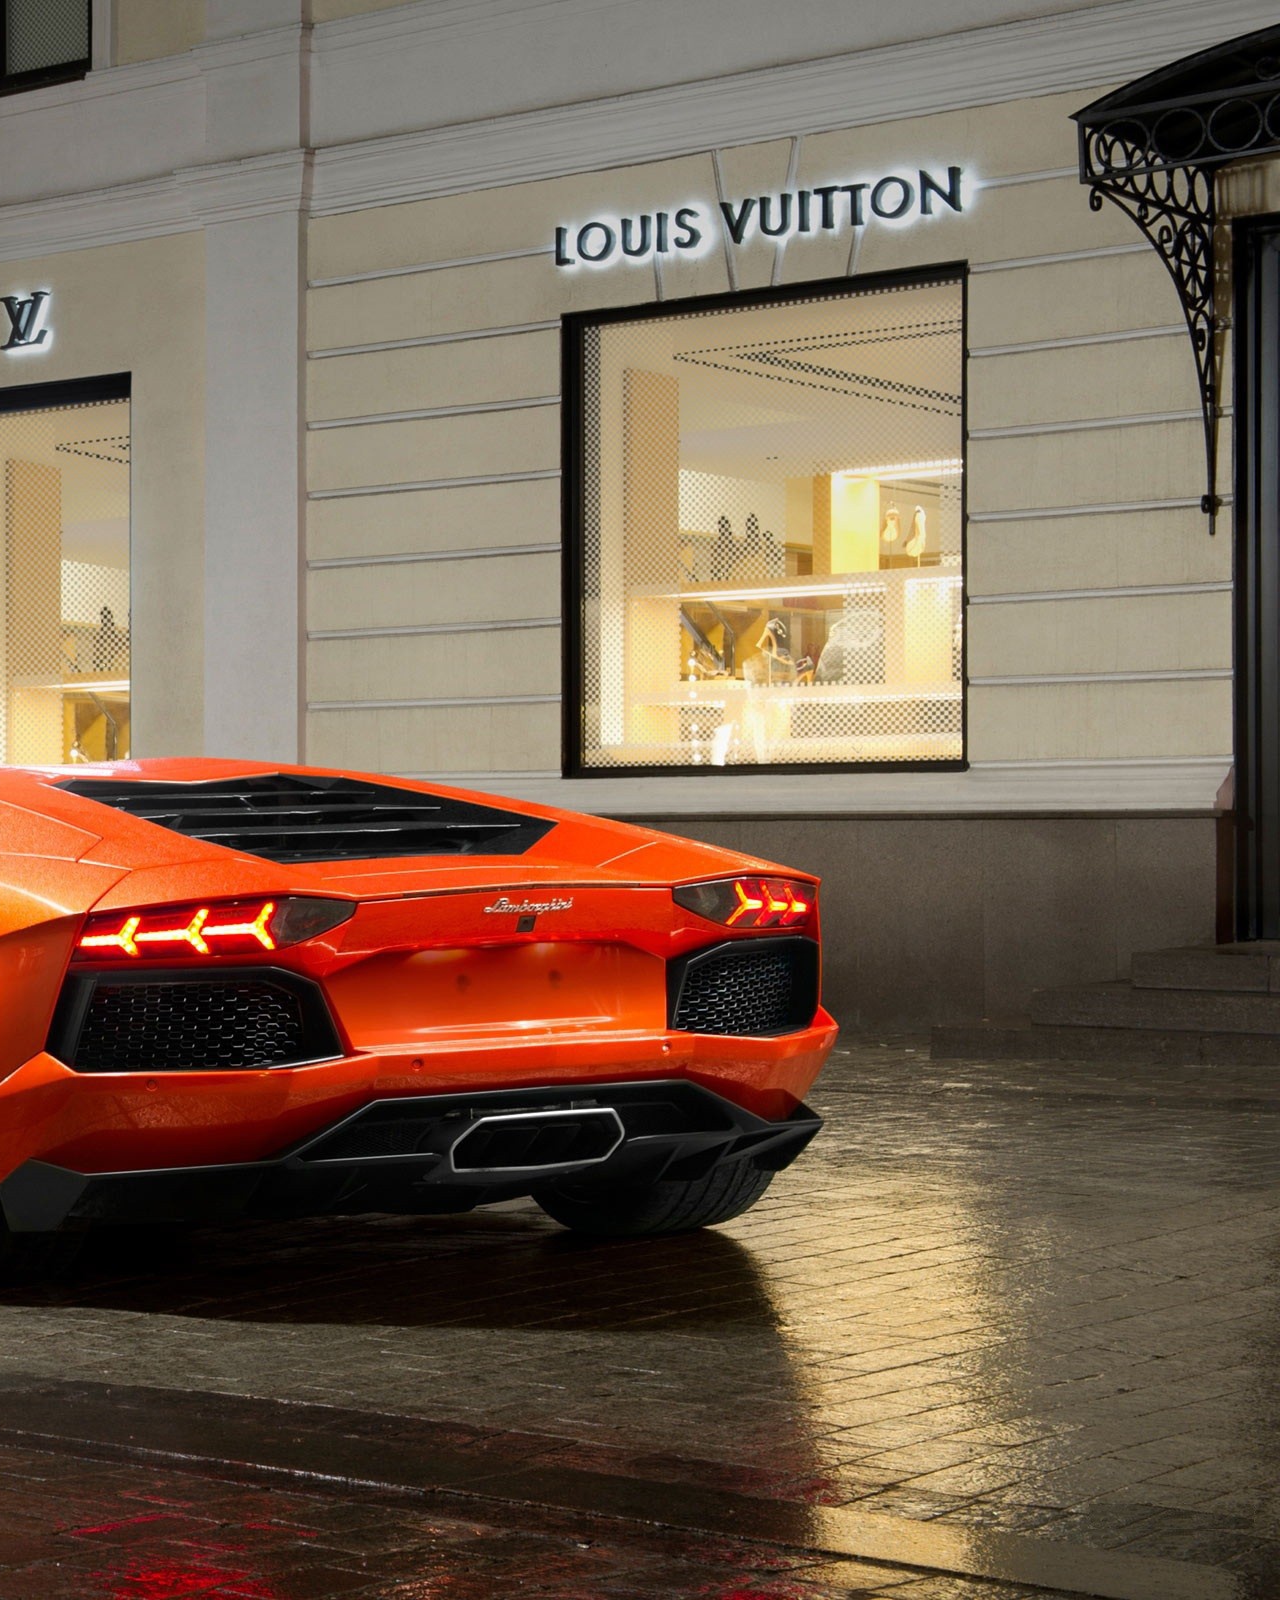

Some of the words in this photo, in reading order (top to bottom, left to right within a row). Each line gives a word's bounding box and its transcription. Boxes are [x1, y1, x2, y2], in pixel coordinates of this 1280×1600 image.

[555, 207, 703, 267] LOUIS
[720, 166, 963, 245] VUITTON
[484, 897, 573, 915] Lamborghini
